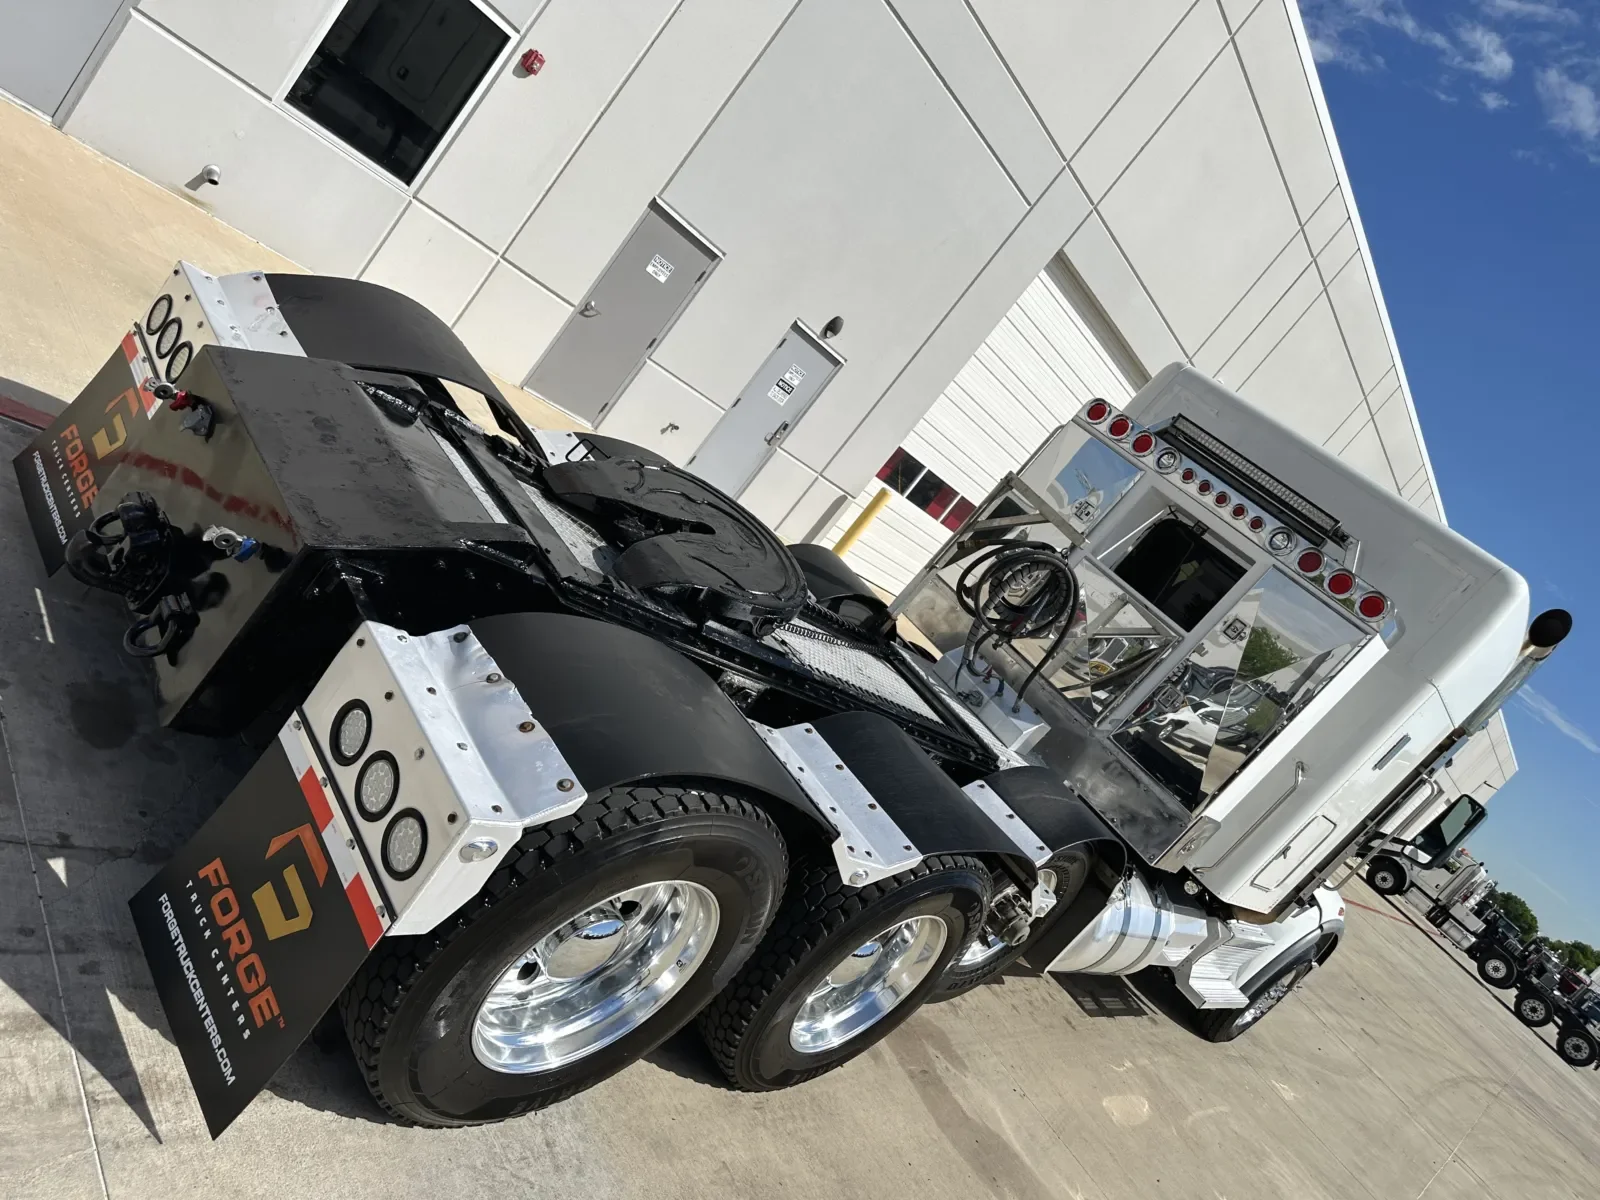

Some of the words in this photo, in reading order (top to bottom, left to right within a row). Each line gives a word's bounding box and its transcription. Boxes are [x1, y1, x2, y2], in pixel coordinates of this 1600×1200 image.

[653, 255, 674, 274] NOTICE
[778, 379, 793, 394] NOTICE
[32, 450, 68, 545] FORGETRUCKCENTERS.COM
[52, 440, 64, 470] TRUCK
[62, 473, 81, 518] CENTERS
[60, 424, 99, 509] FORGE
[158, 893, 236, 1087] FORGETRUCKCENTERS.COM
[185, 880, 212, 940] TRUCK
[211, 948, 251, 1040] CENTERS
